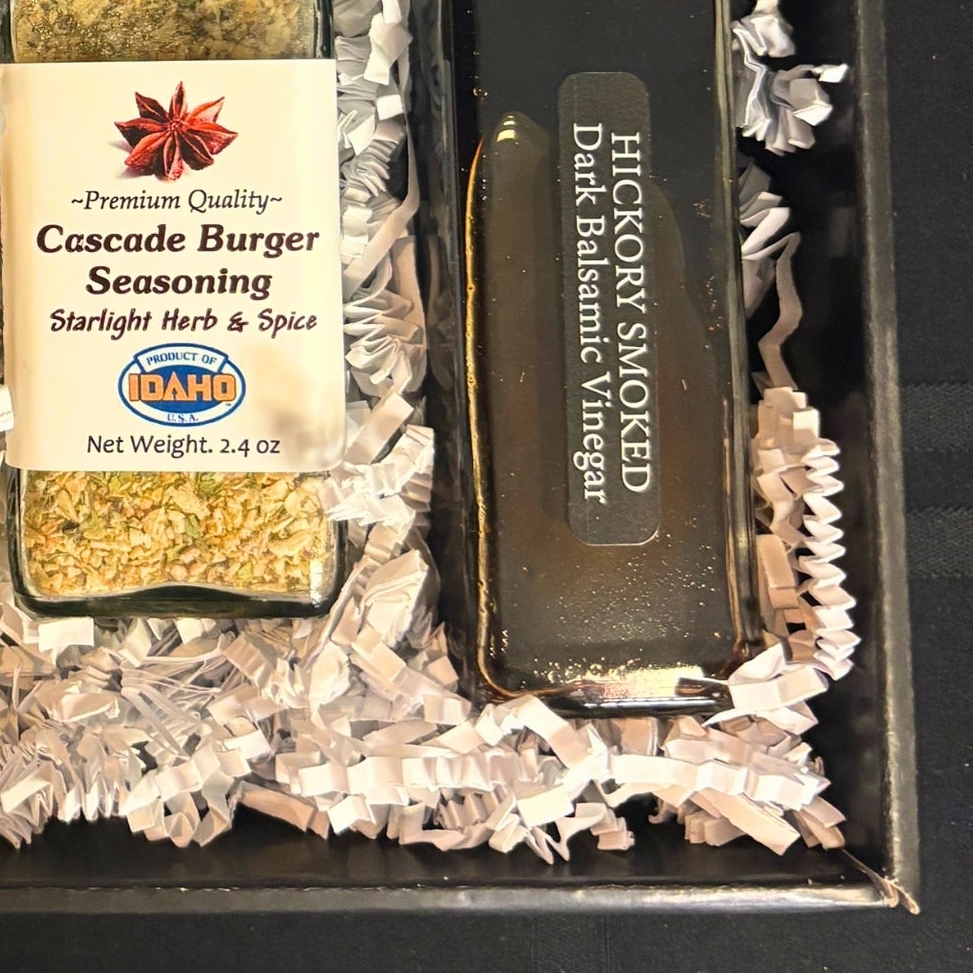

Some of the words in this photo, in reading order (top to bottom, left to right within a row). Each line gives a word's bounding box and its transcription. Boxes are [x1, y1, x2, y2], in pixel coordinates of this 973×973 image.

[573, 122, 607, 207] Dark
[36, 223, 186, 254] Cascade
[197, 223, 320, 259] Burger
[611, 132, 647, 314] HICKORY
[85, 265, 273, 301] Seasoning
[576, 215, 610, 363] Balsamic
[50, 308, 153, 341] Starlight
[161, 307, 218, 332] Herb
[226, 311, 249, 333] &
[257, 308, 317, 339] Spice
[145, 351, 199, 366] PRODUCT
[201, 354, 218, 366] OF
[128, 371, 237, 402] IDAHO
[617, 322, 652, 493] SMOKED
[87, 435, 124, 454] Net
[130, 434, 213, 459] Weight.
[219, 438, 250, 458] 2.4
[256, 439, 281, 454] oz
[572, 371, 613, 505] Vinegar
